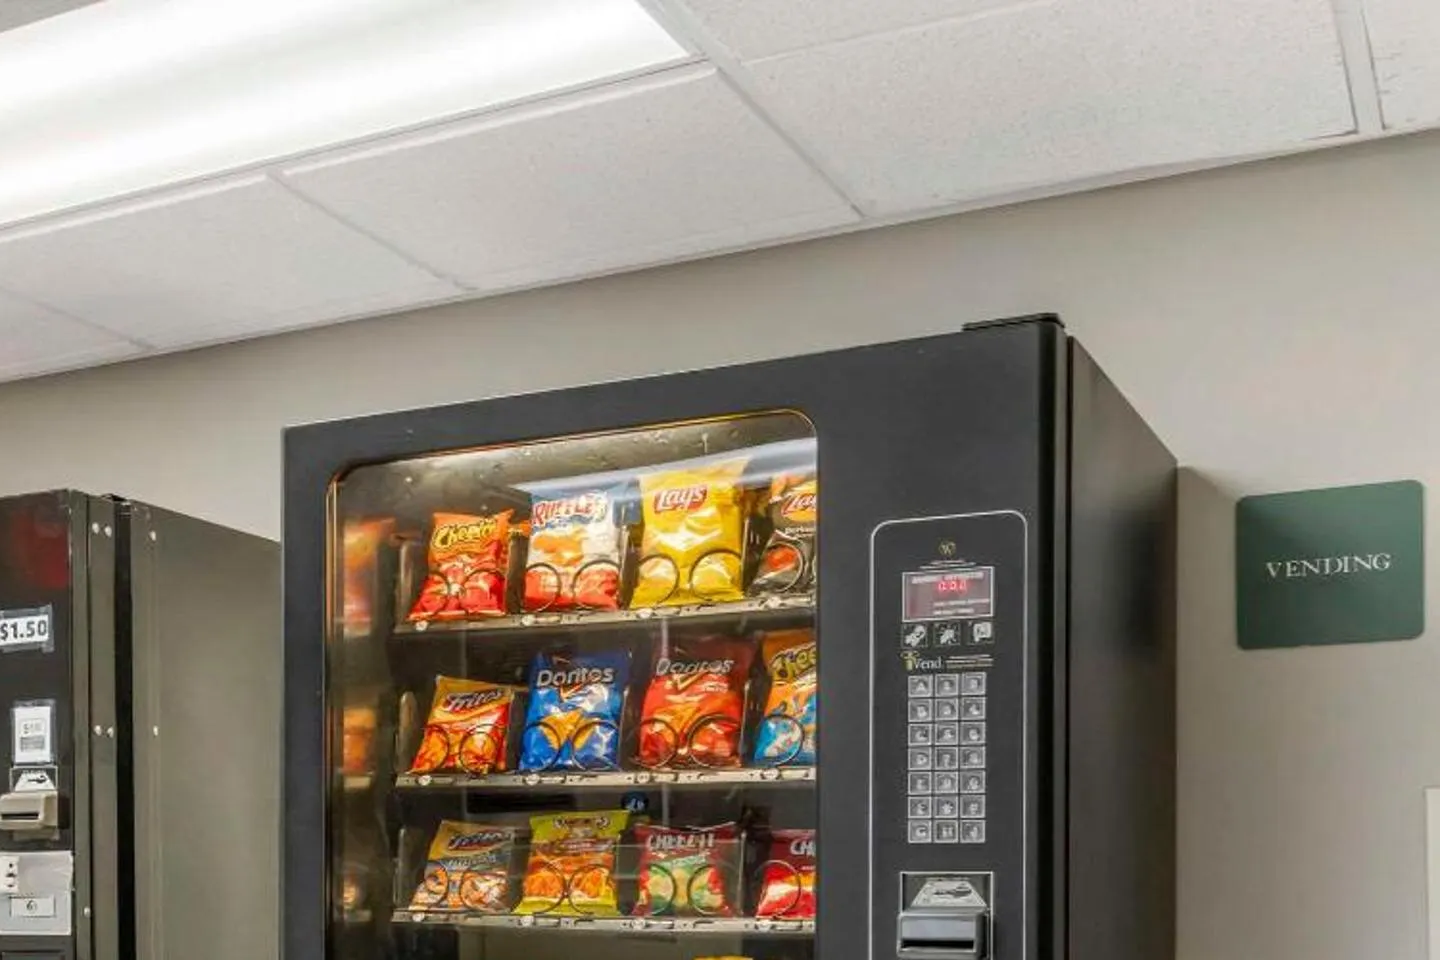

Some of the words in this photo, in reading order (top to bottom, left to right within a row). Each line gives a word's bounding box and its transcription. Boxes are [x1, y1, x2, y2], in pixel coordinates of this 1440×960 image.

[1266, 553, 1391, 578] VENDING
[0, 619, 48, 641] $1.50
[537, 667, 615, 687] Doritos
[656, 659, 734, 676] Doritos
[448, 688, 503, 711] Fritos
